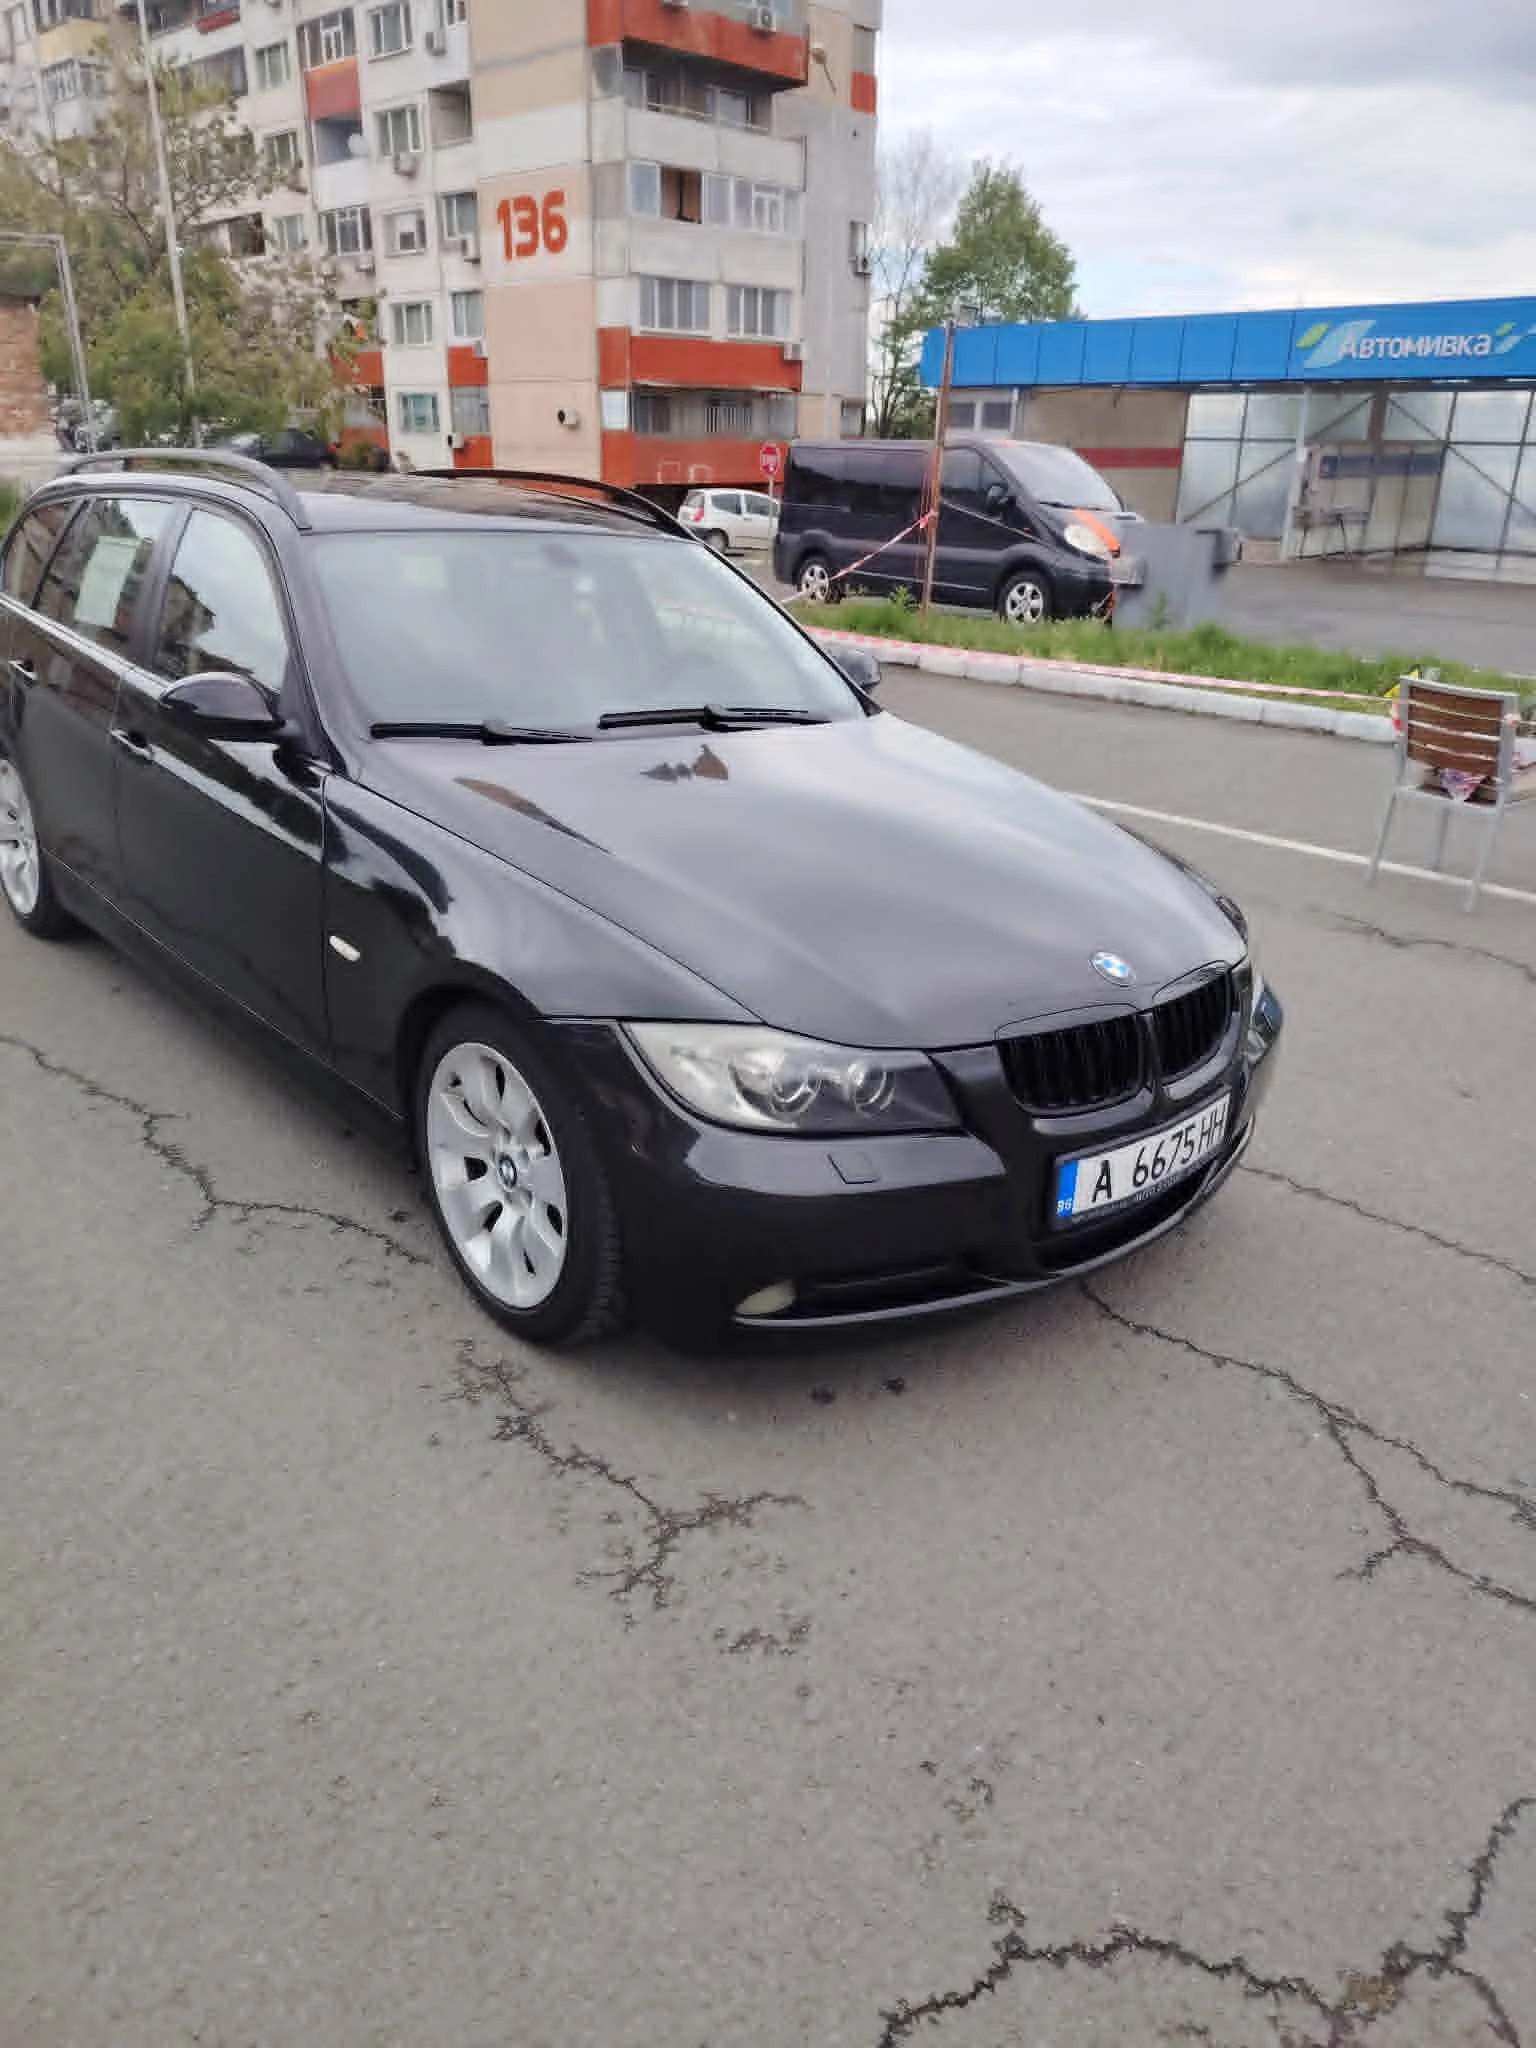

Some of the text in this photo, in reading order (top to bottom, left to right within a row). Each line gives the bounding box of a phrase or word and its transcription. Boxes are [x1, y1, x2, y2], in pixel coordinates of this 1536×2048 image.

[497, 190, 567, 262] 136
[1092, 1159, 1113, 1203] A
[1132, 1124, 1196, 1187] 6675
